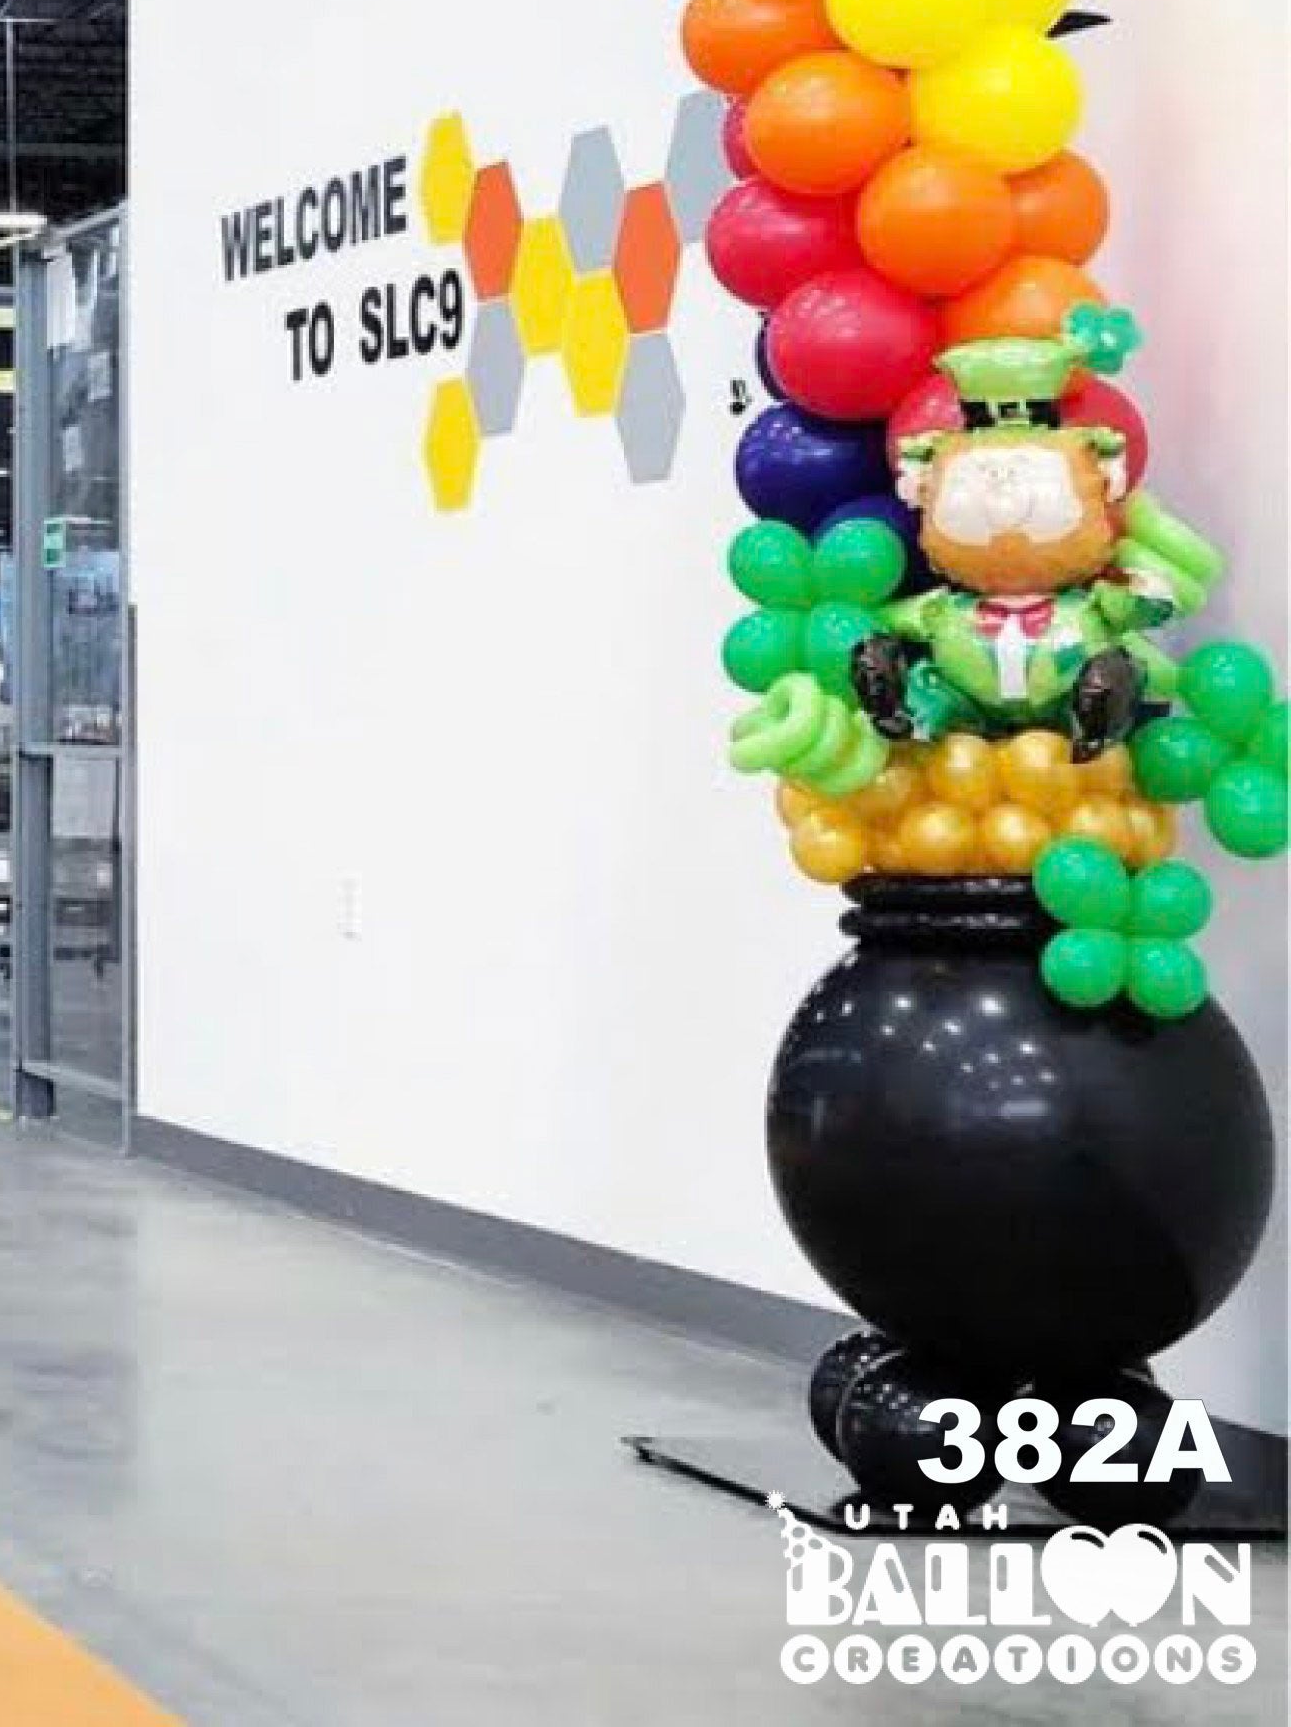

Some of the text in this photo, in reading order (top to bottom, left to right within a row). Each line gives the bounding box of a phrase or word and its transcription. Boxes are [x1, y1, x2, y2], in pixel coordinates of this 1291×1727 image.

[221, 156, 407, 281] WELCOME
[285, 270, 464, 382] TO SLC9
